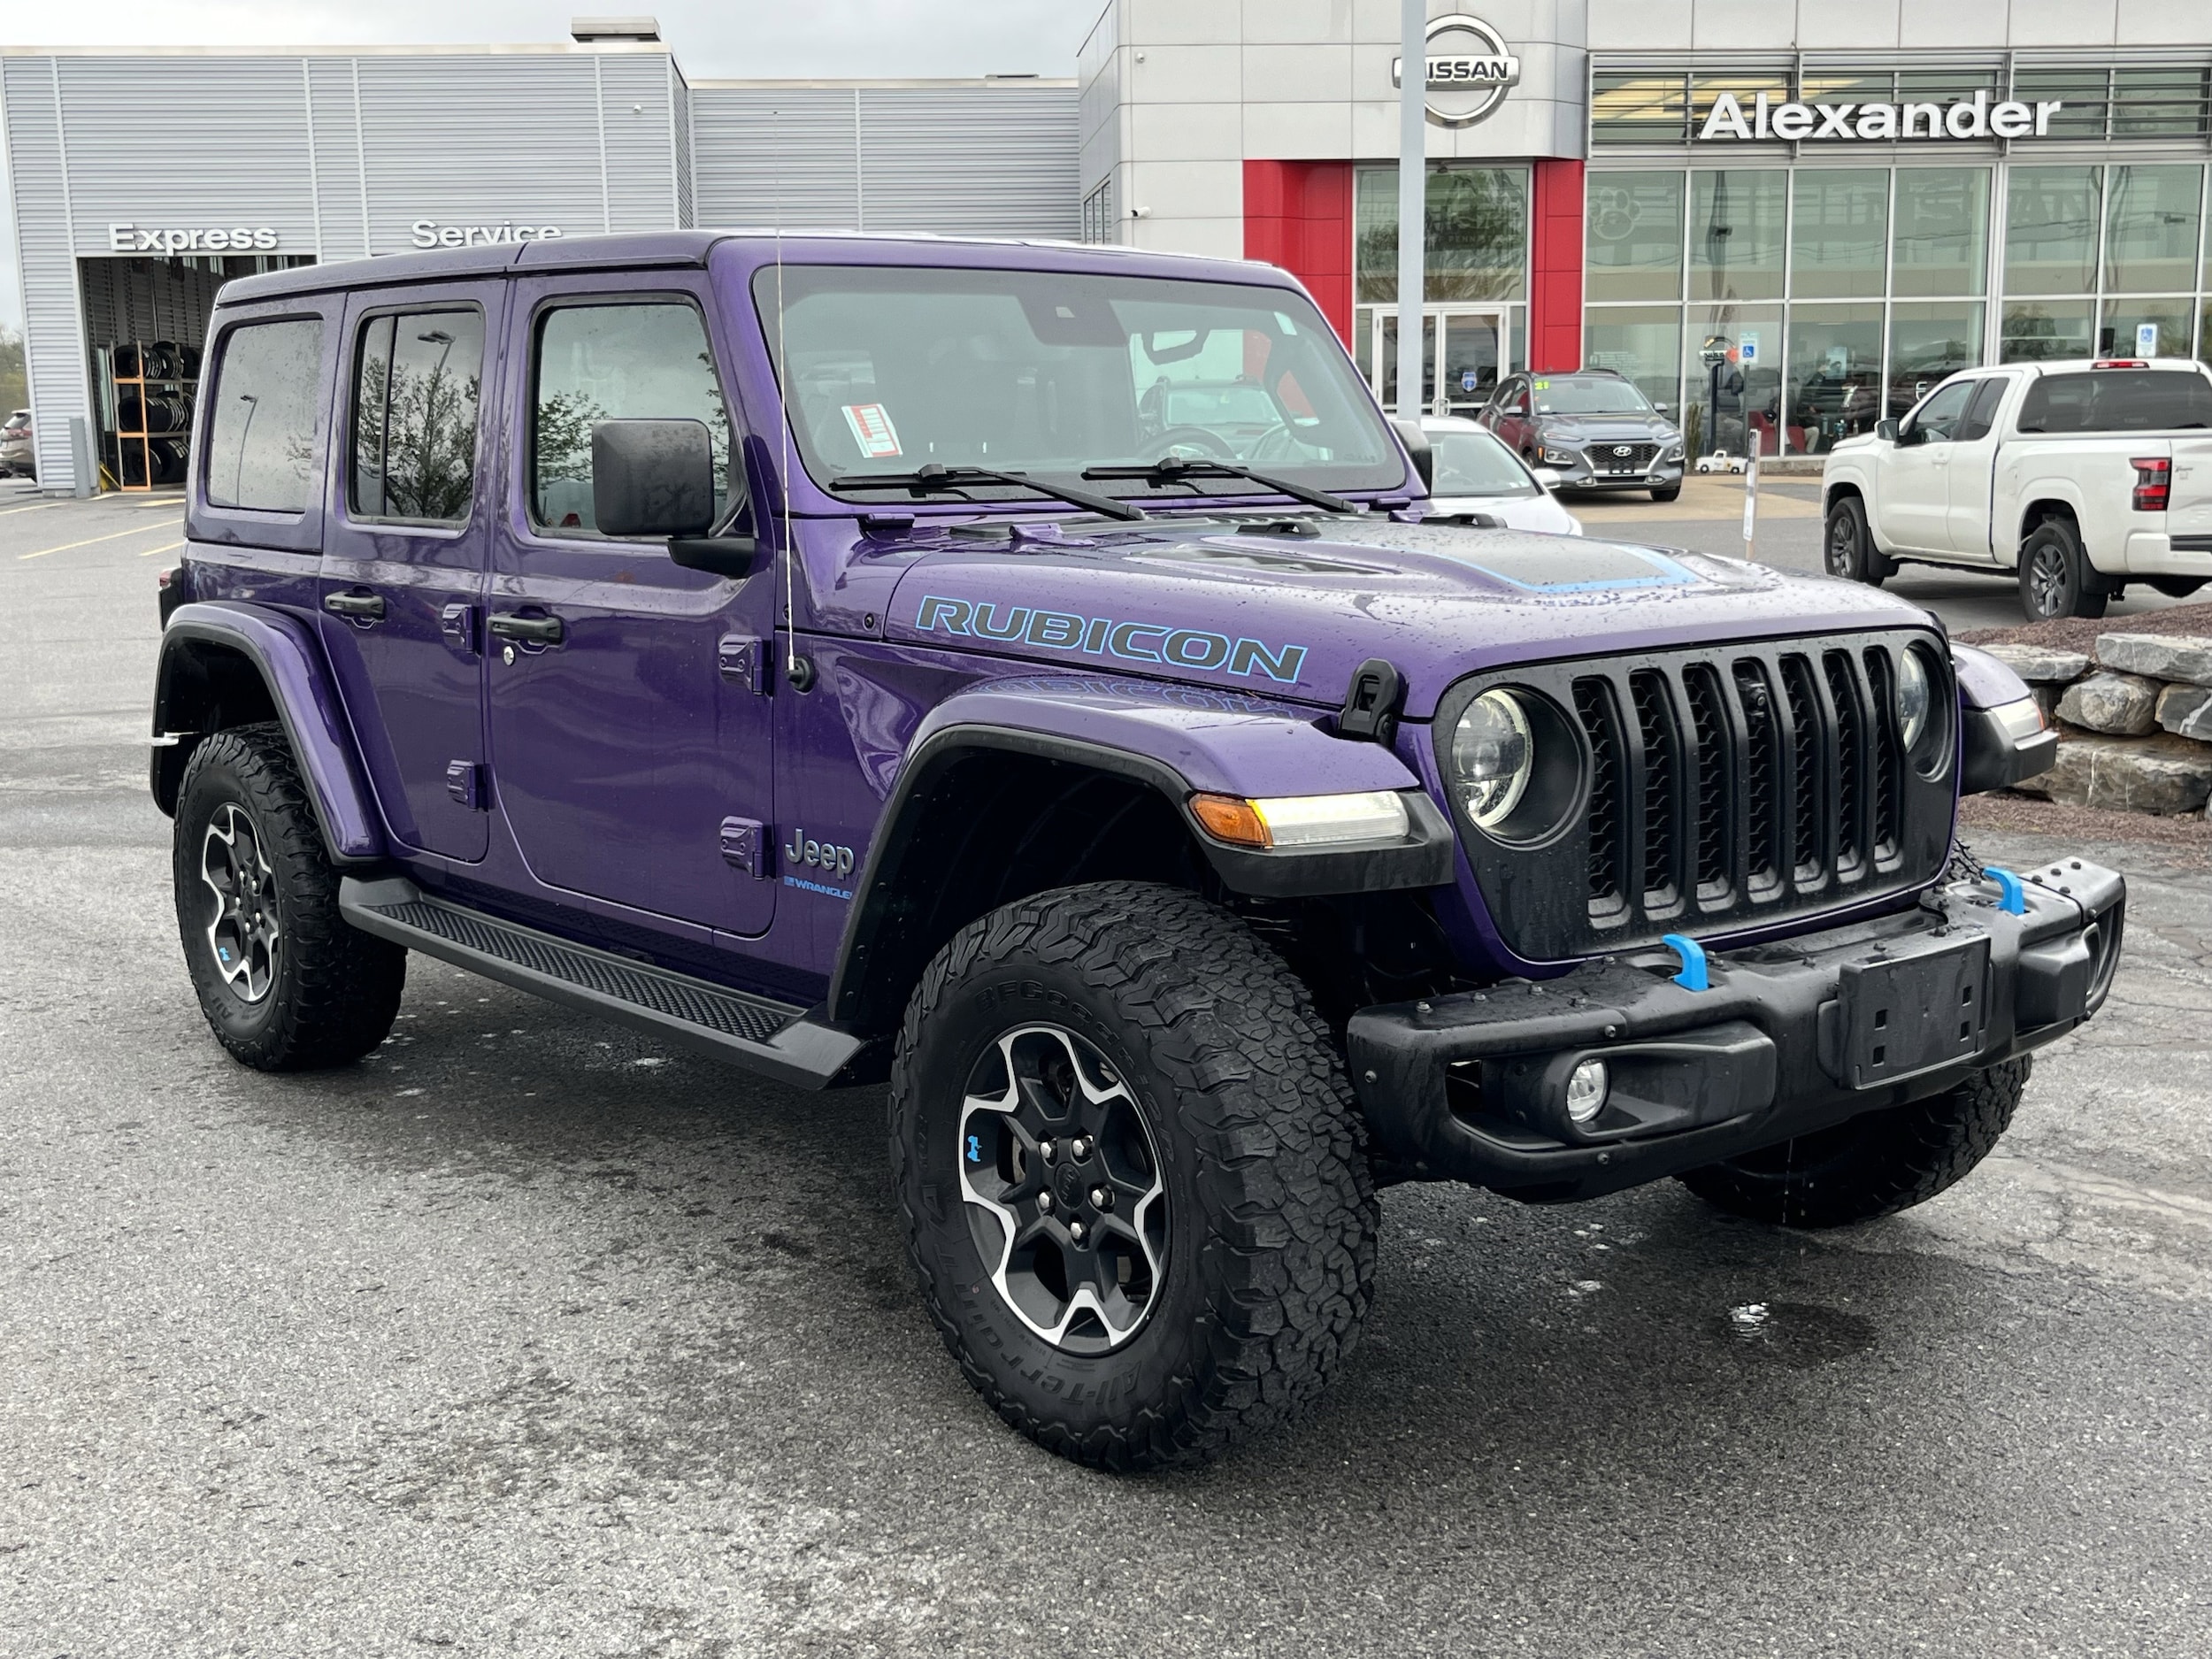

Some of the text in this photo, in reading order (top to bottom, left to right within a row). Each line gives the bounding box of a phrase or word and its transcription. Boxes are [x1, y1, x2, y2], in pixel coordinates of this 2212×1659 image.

[1427, 61, 1509, 79] ISSAN
[1699, 89, 2062, 141] Alexander
[108, 219, 563, 257] Express Service
[916, 595, 1309, 684] RUBICON
[785, 827, 856, 881] Jeep
